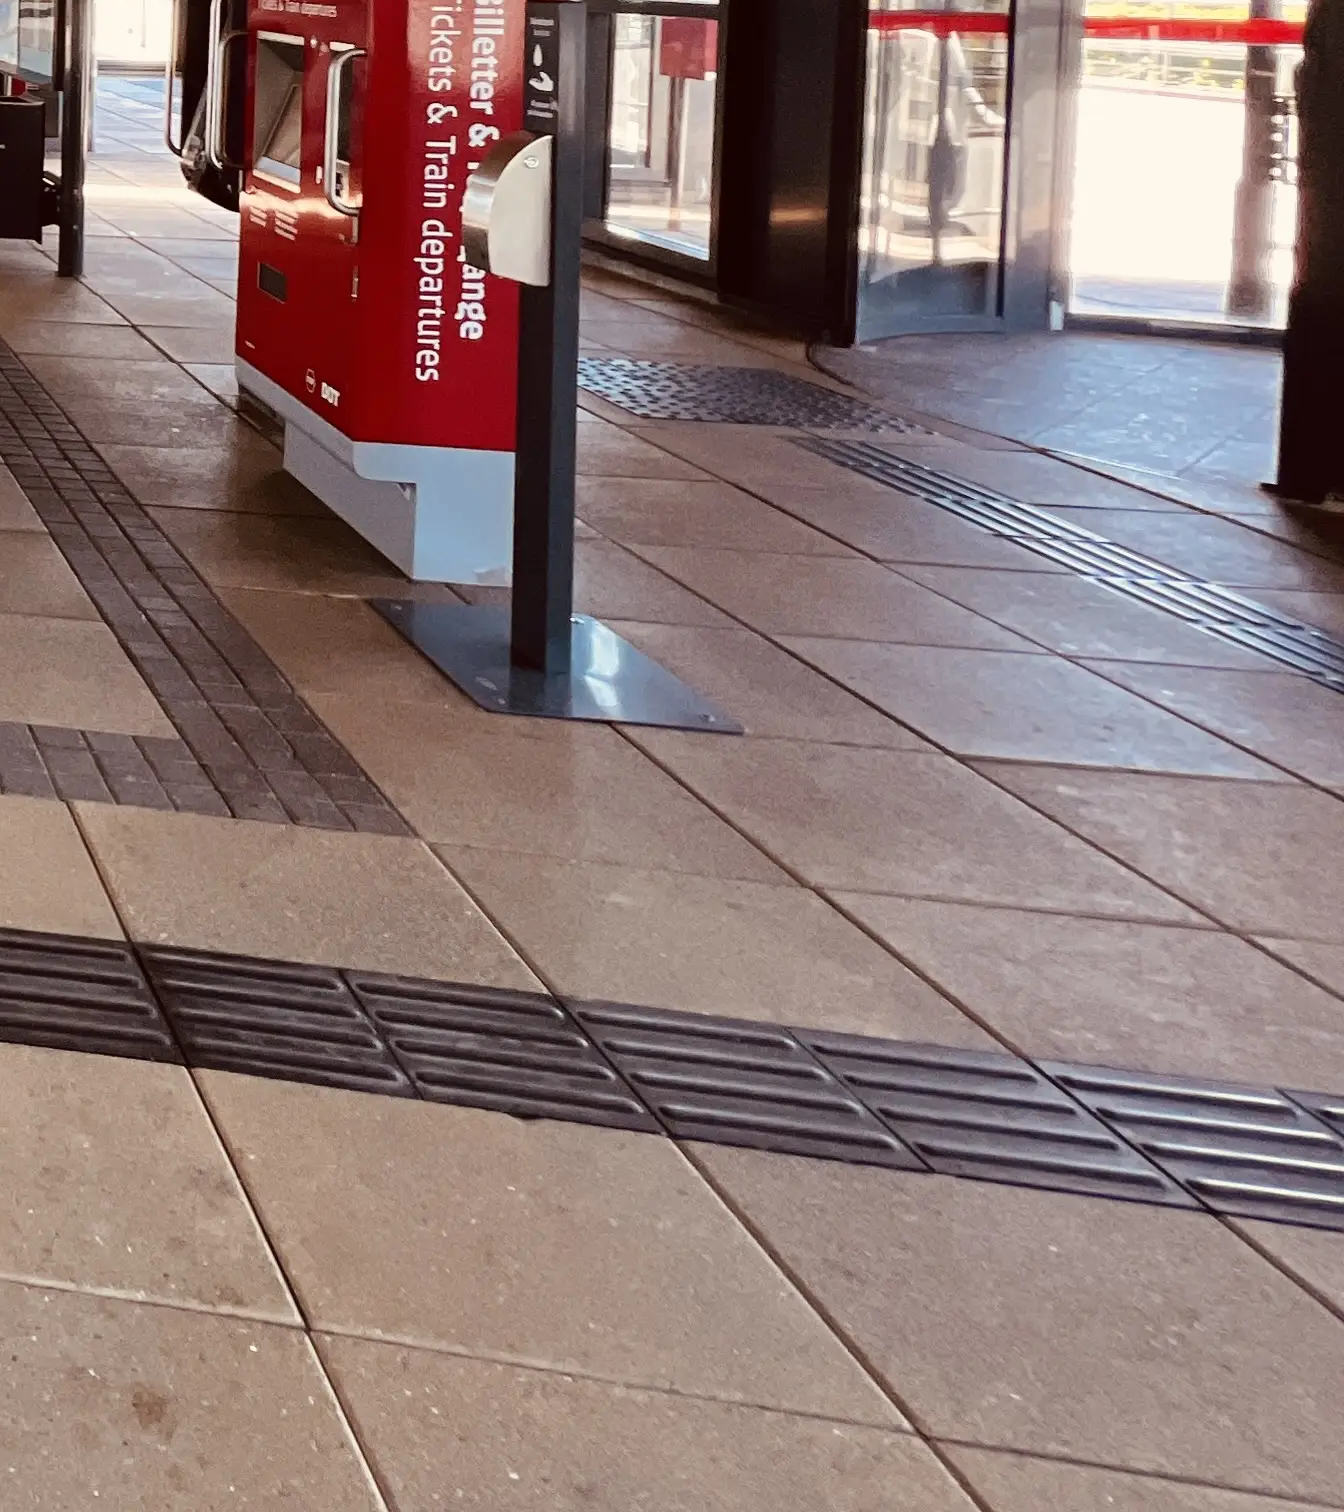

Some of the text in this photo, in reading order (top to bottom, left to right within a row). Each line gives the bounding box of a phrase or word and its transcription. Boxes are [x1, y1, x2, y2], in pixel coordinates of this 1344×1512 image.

[426, 102, 458, 125] &
[468, 122, 500, 148] &
[423, 135, 457, 208] Train
[413, 219, 454, 382] departures
